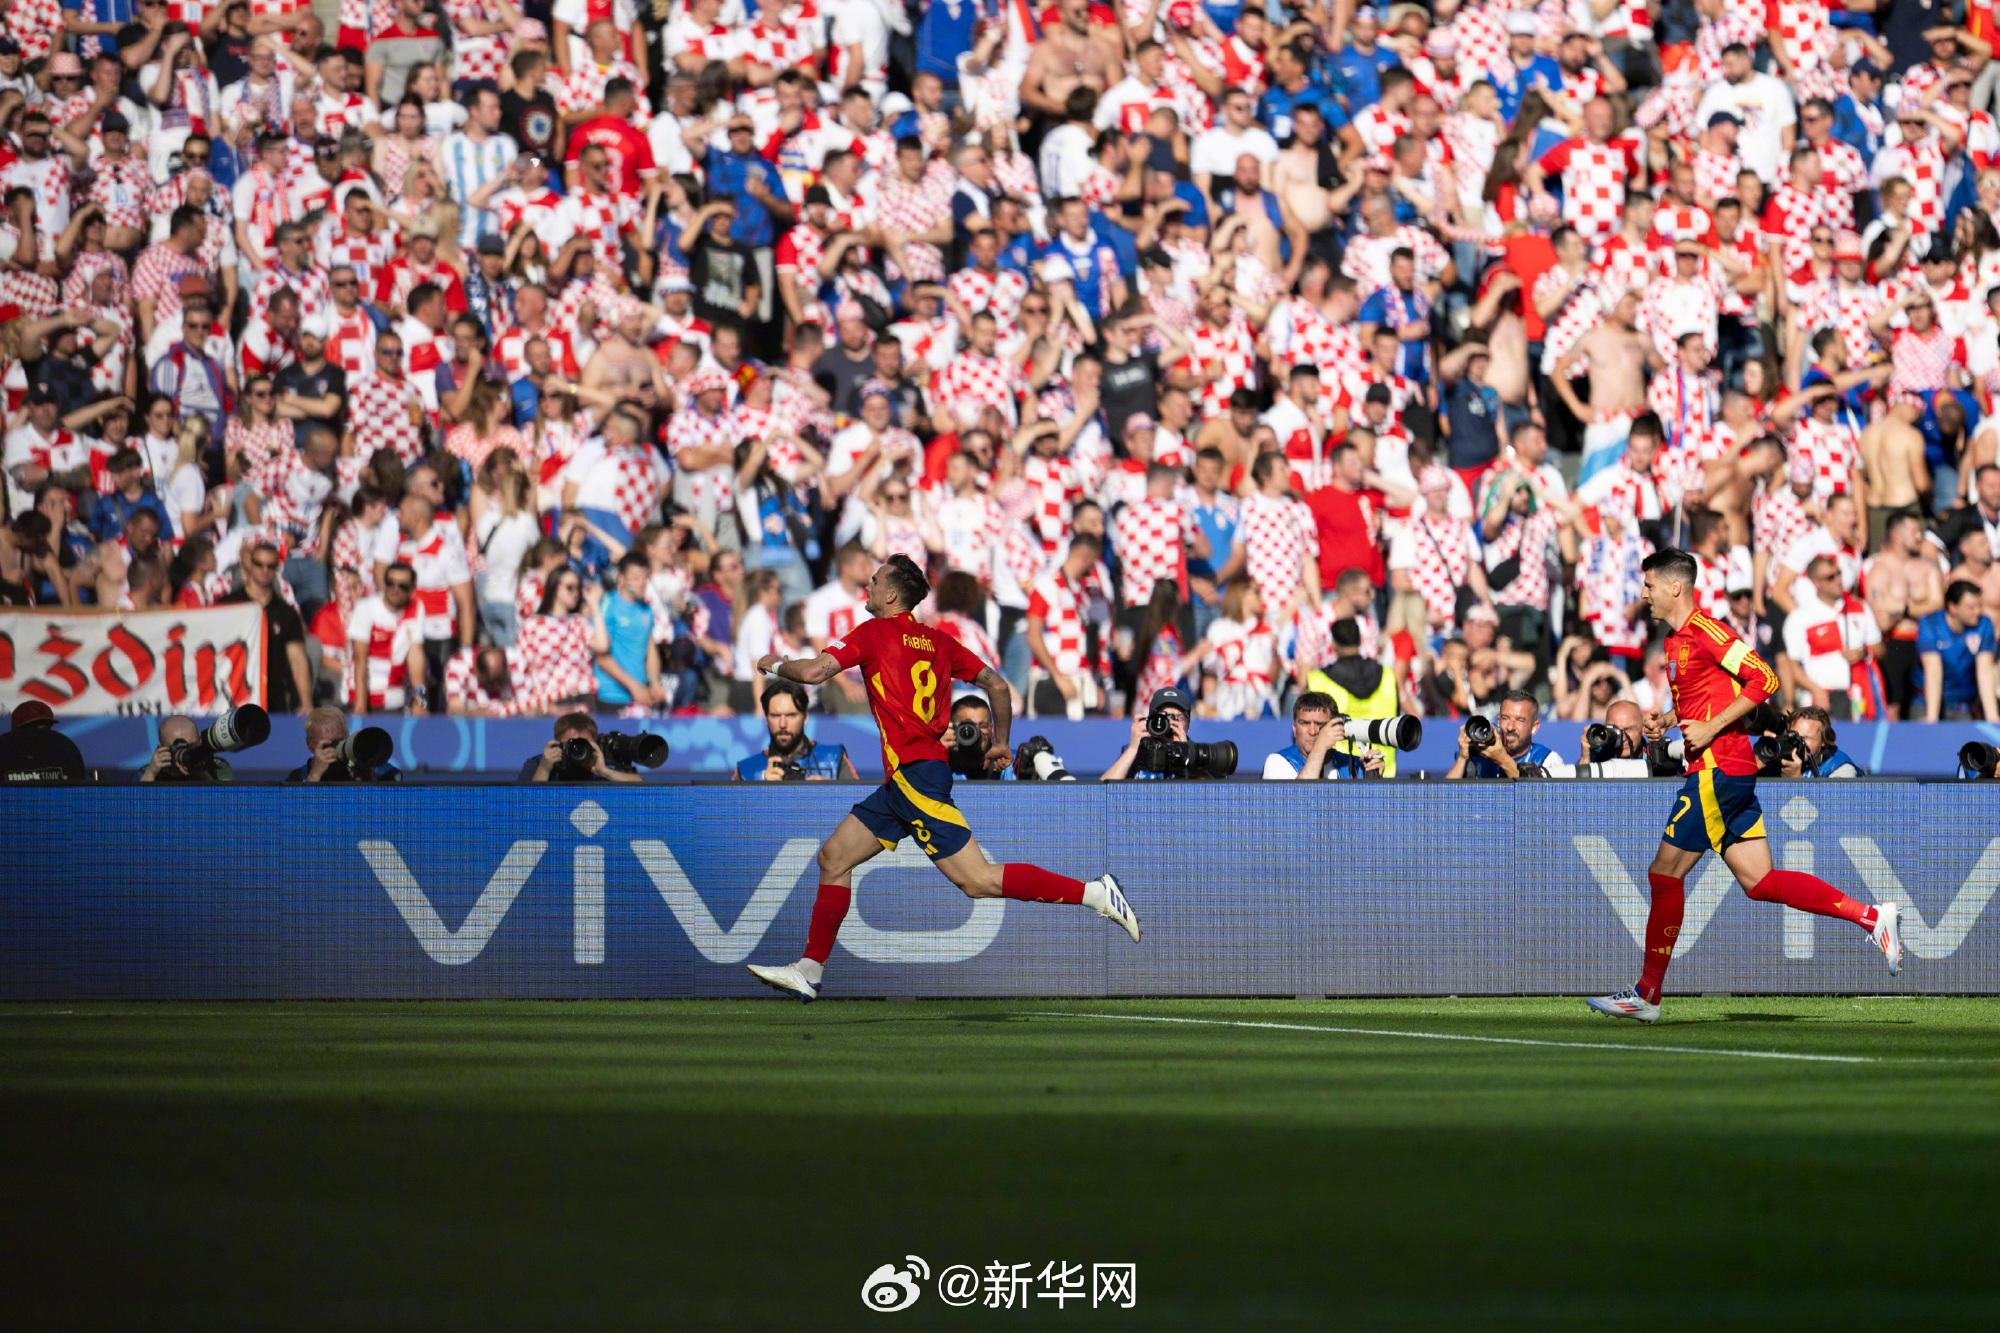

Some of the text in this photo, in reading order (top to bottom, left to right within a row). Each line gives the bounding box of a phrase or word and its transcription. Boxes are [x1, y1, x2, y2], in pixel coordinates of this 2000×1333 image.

[911, 660, 937, 725] 8
[911, 819, 932, 842] 8
[1672, 795, 1692, 822] 7
[357, 801, 1006, 965] vivo
